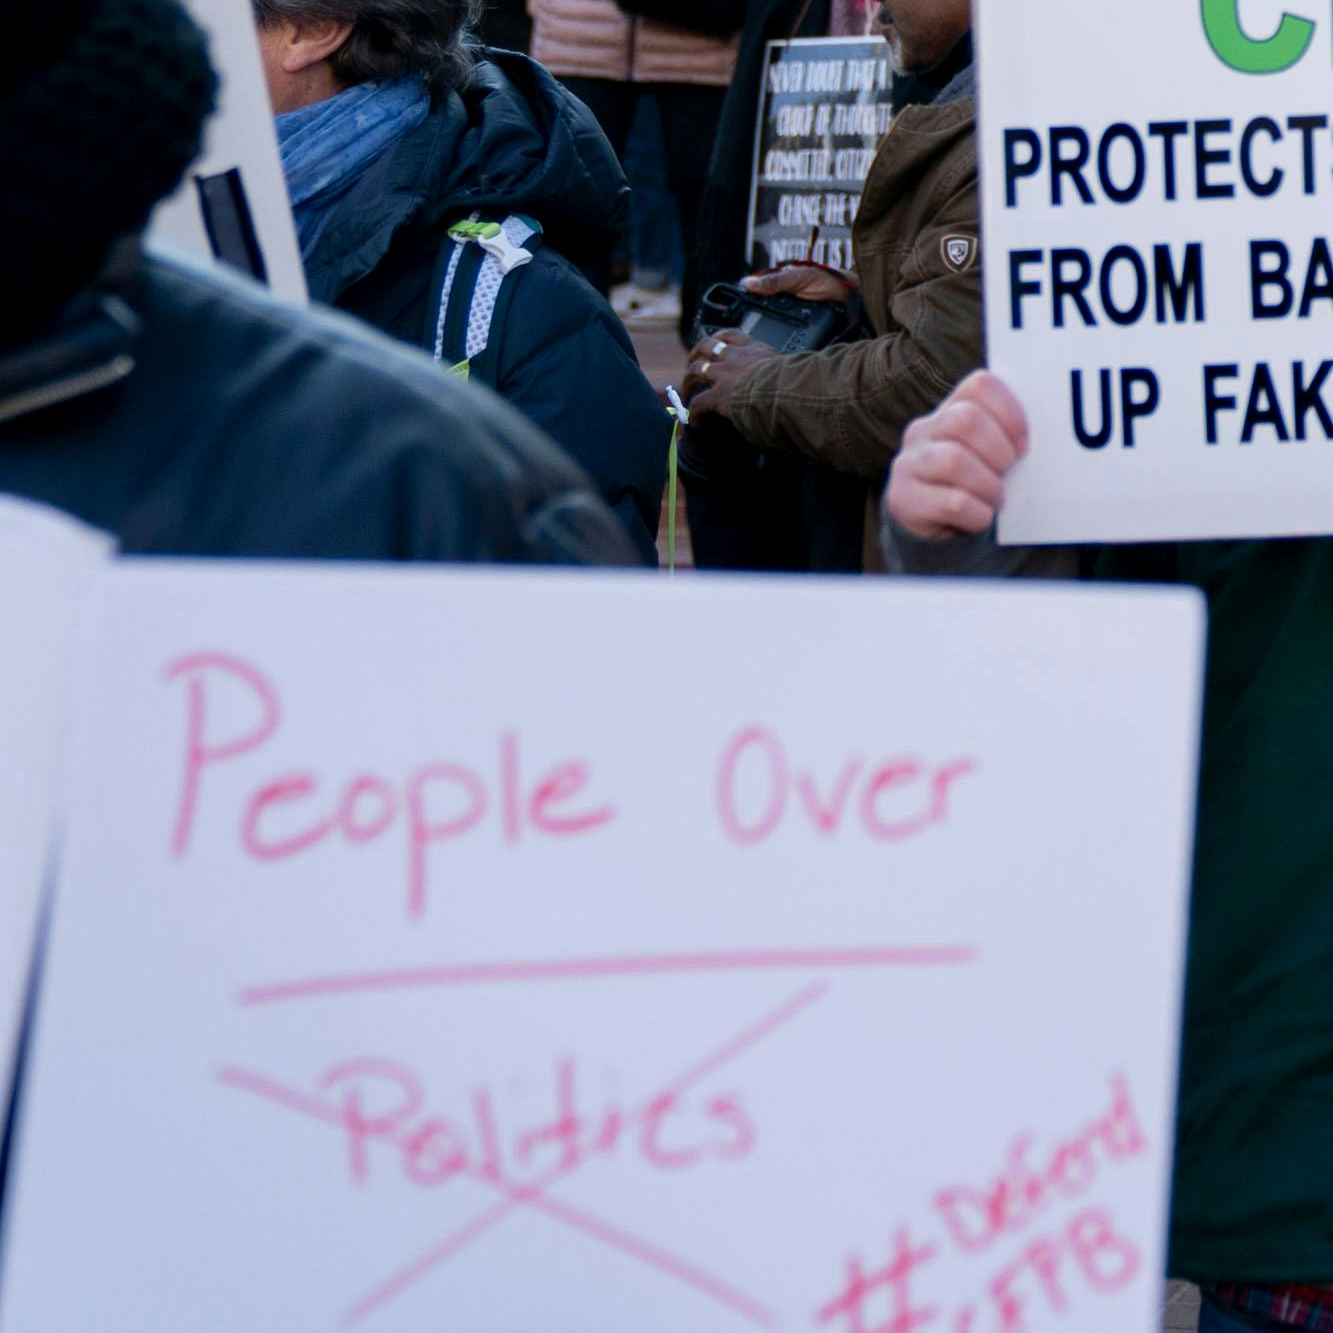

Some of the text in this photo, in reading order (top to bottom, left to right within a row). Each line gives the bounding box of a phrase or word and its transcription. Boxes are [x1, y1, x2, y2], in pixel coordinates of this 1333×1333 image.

[1008, 241, 1205, 330] FROM
[1070, 366, 1160, 450] UP
[168, 652, 977, 916] People Over
[318, 1054, 757, 1188] Politics
